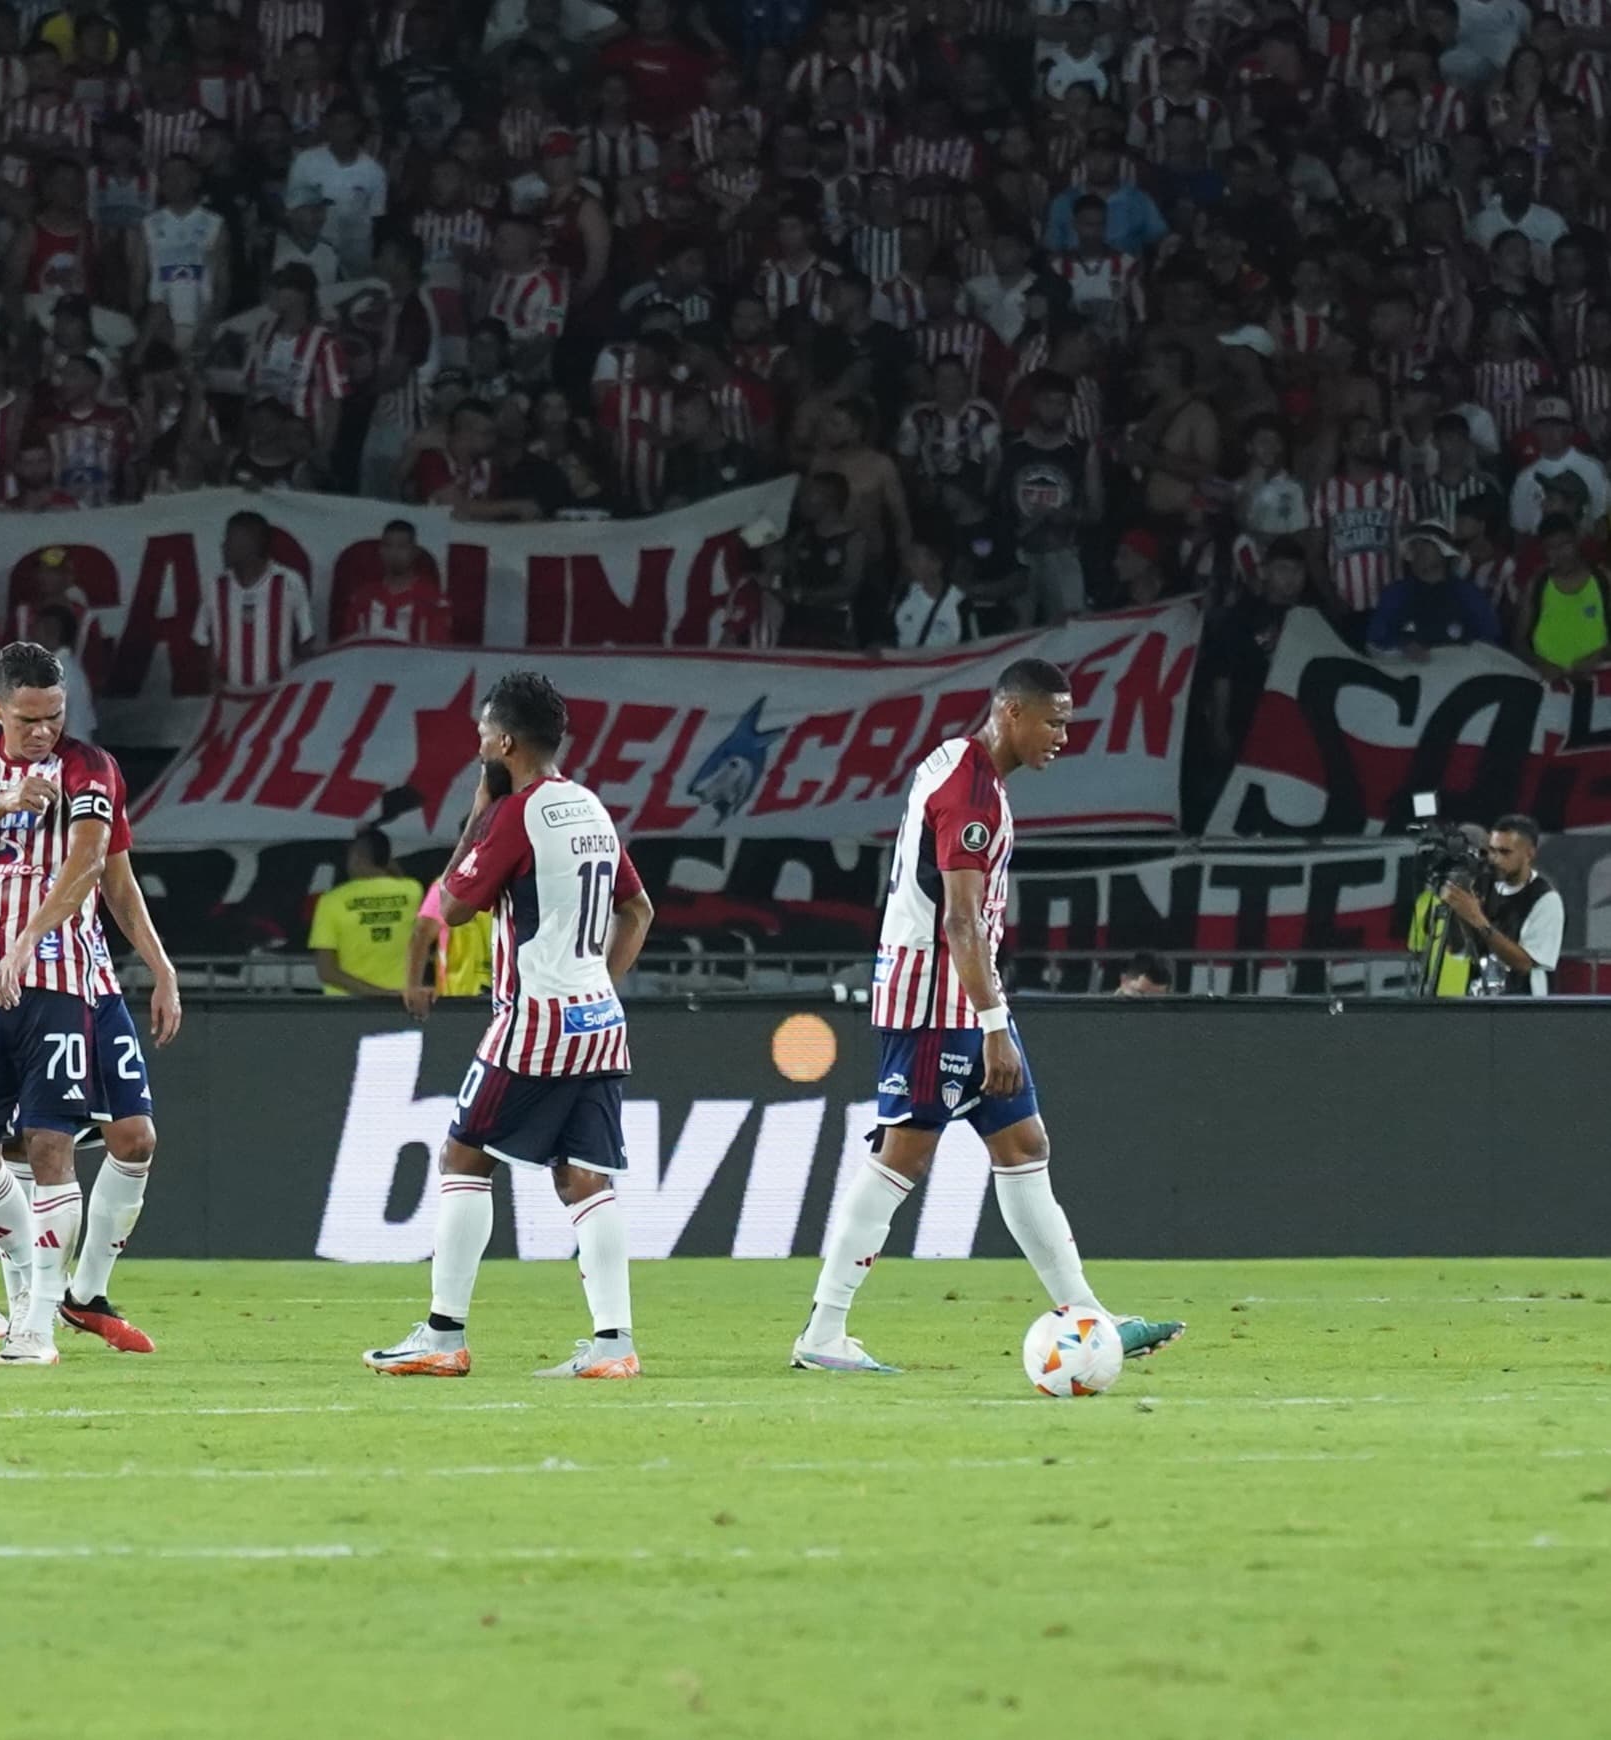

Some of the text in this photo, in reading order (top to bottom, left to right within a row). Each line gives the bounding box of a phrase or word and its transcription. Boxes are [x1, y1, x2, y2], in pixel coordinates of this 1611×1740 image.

[755, 632, 1195, 798] CAREN
[571, 834, 615, 855] CARIACO
[577, 861, 613, 958] 10
[44, 1033, 87, 1080] 70
[113, 1035, 146, 1080] 2
[458, 1060, 485, 1109] 0
[315, 1012, 992, 1262] bwin
